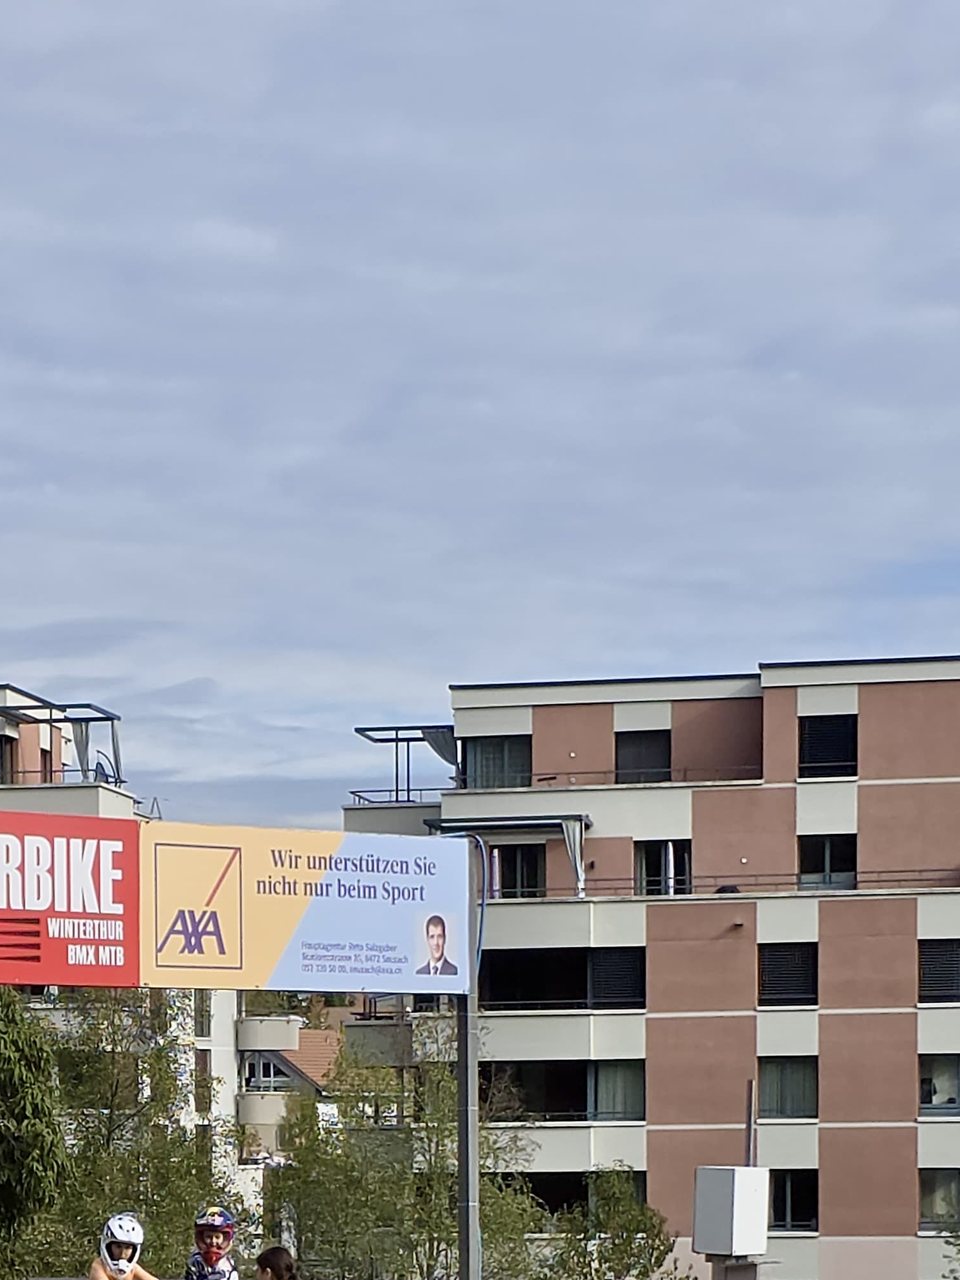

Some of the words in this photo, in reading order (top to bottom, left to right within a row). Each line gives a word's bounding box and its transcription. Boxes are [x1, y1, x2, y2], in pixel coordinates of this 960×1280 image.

[271, 849, 302, 870] Wir
[307, 853, 410, 875] unterstützen
[413, 856, 437, 876] Sie
[256, 875, 299, 896] nicht
[303, 881, 332, 898] nur
[337, 878, 377, 900] beim
[381, 881, 425, 905] Sport
[47, 917, 124, 941] WINTERTHUR
[157, 909, 227, 956] AXA
[68, 945, 96, 966] BMX
[98, 945, 124, 967] MTB
